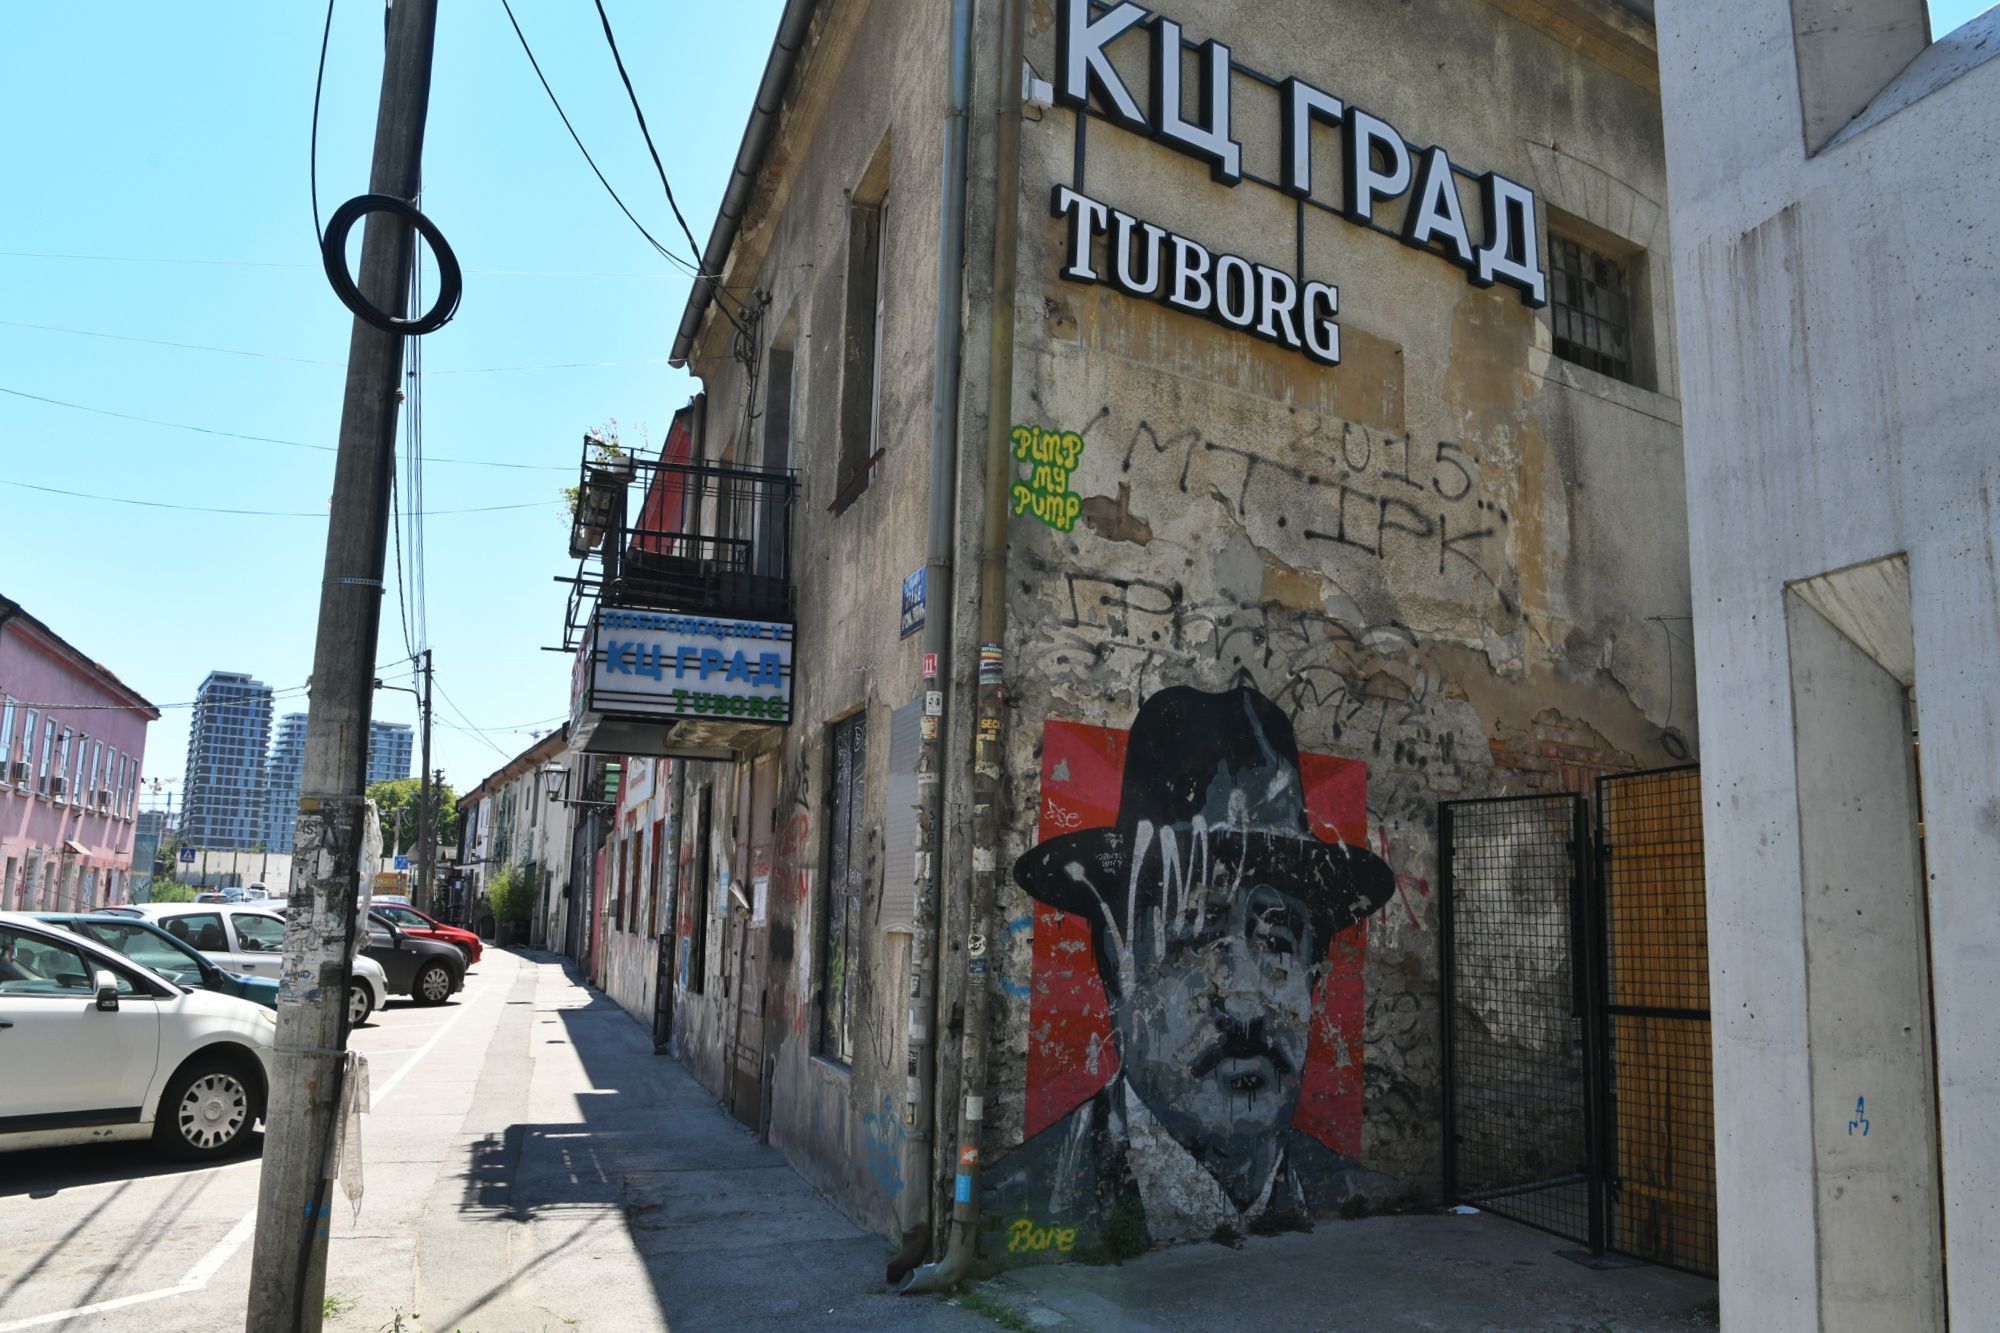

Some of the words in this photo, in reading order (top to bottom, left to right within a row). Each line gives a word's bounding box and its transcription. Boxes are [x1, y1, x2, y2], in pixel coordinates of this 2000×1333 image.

[1058, 0, 1242, 187] КЦ
[1281, 76, 1547, 309] ГРАД
[1052, 183, 1340, 366] TUBORG
[606, 640, 662, 681] КЦ
[675, 646, 782, 689] ГРАД
[672, 689, 783, 719] TUBORG
